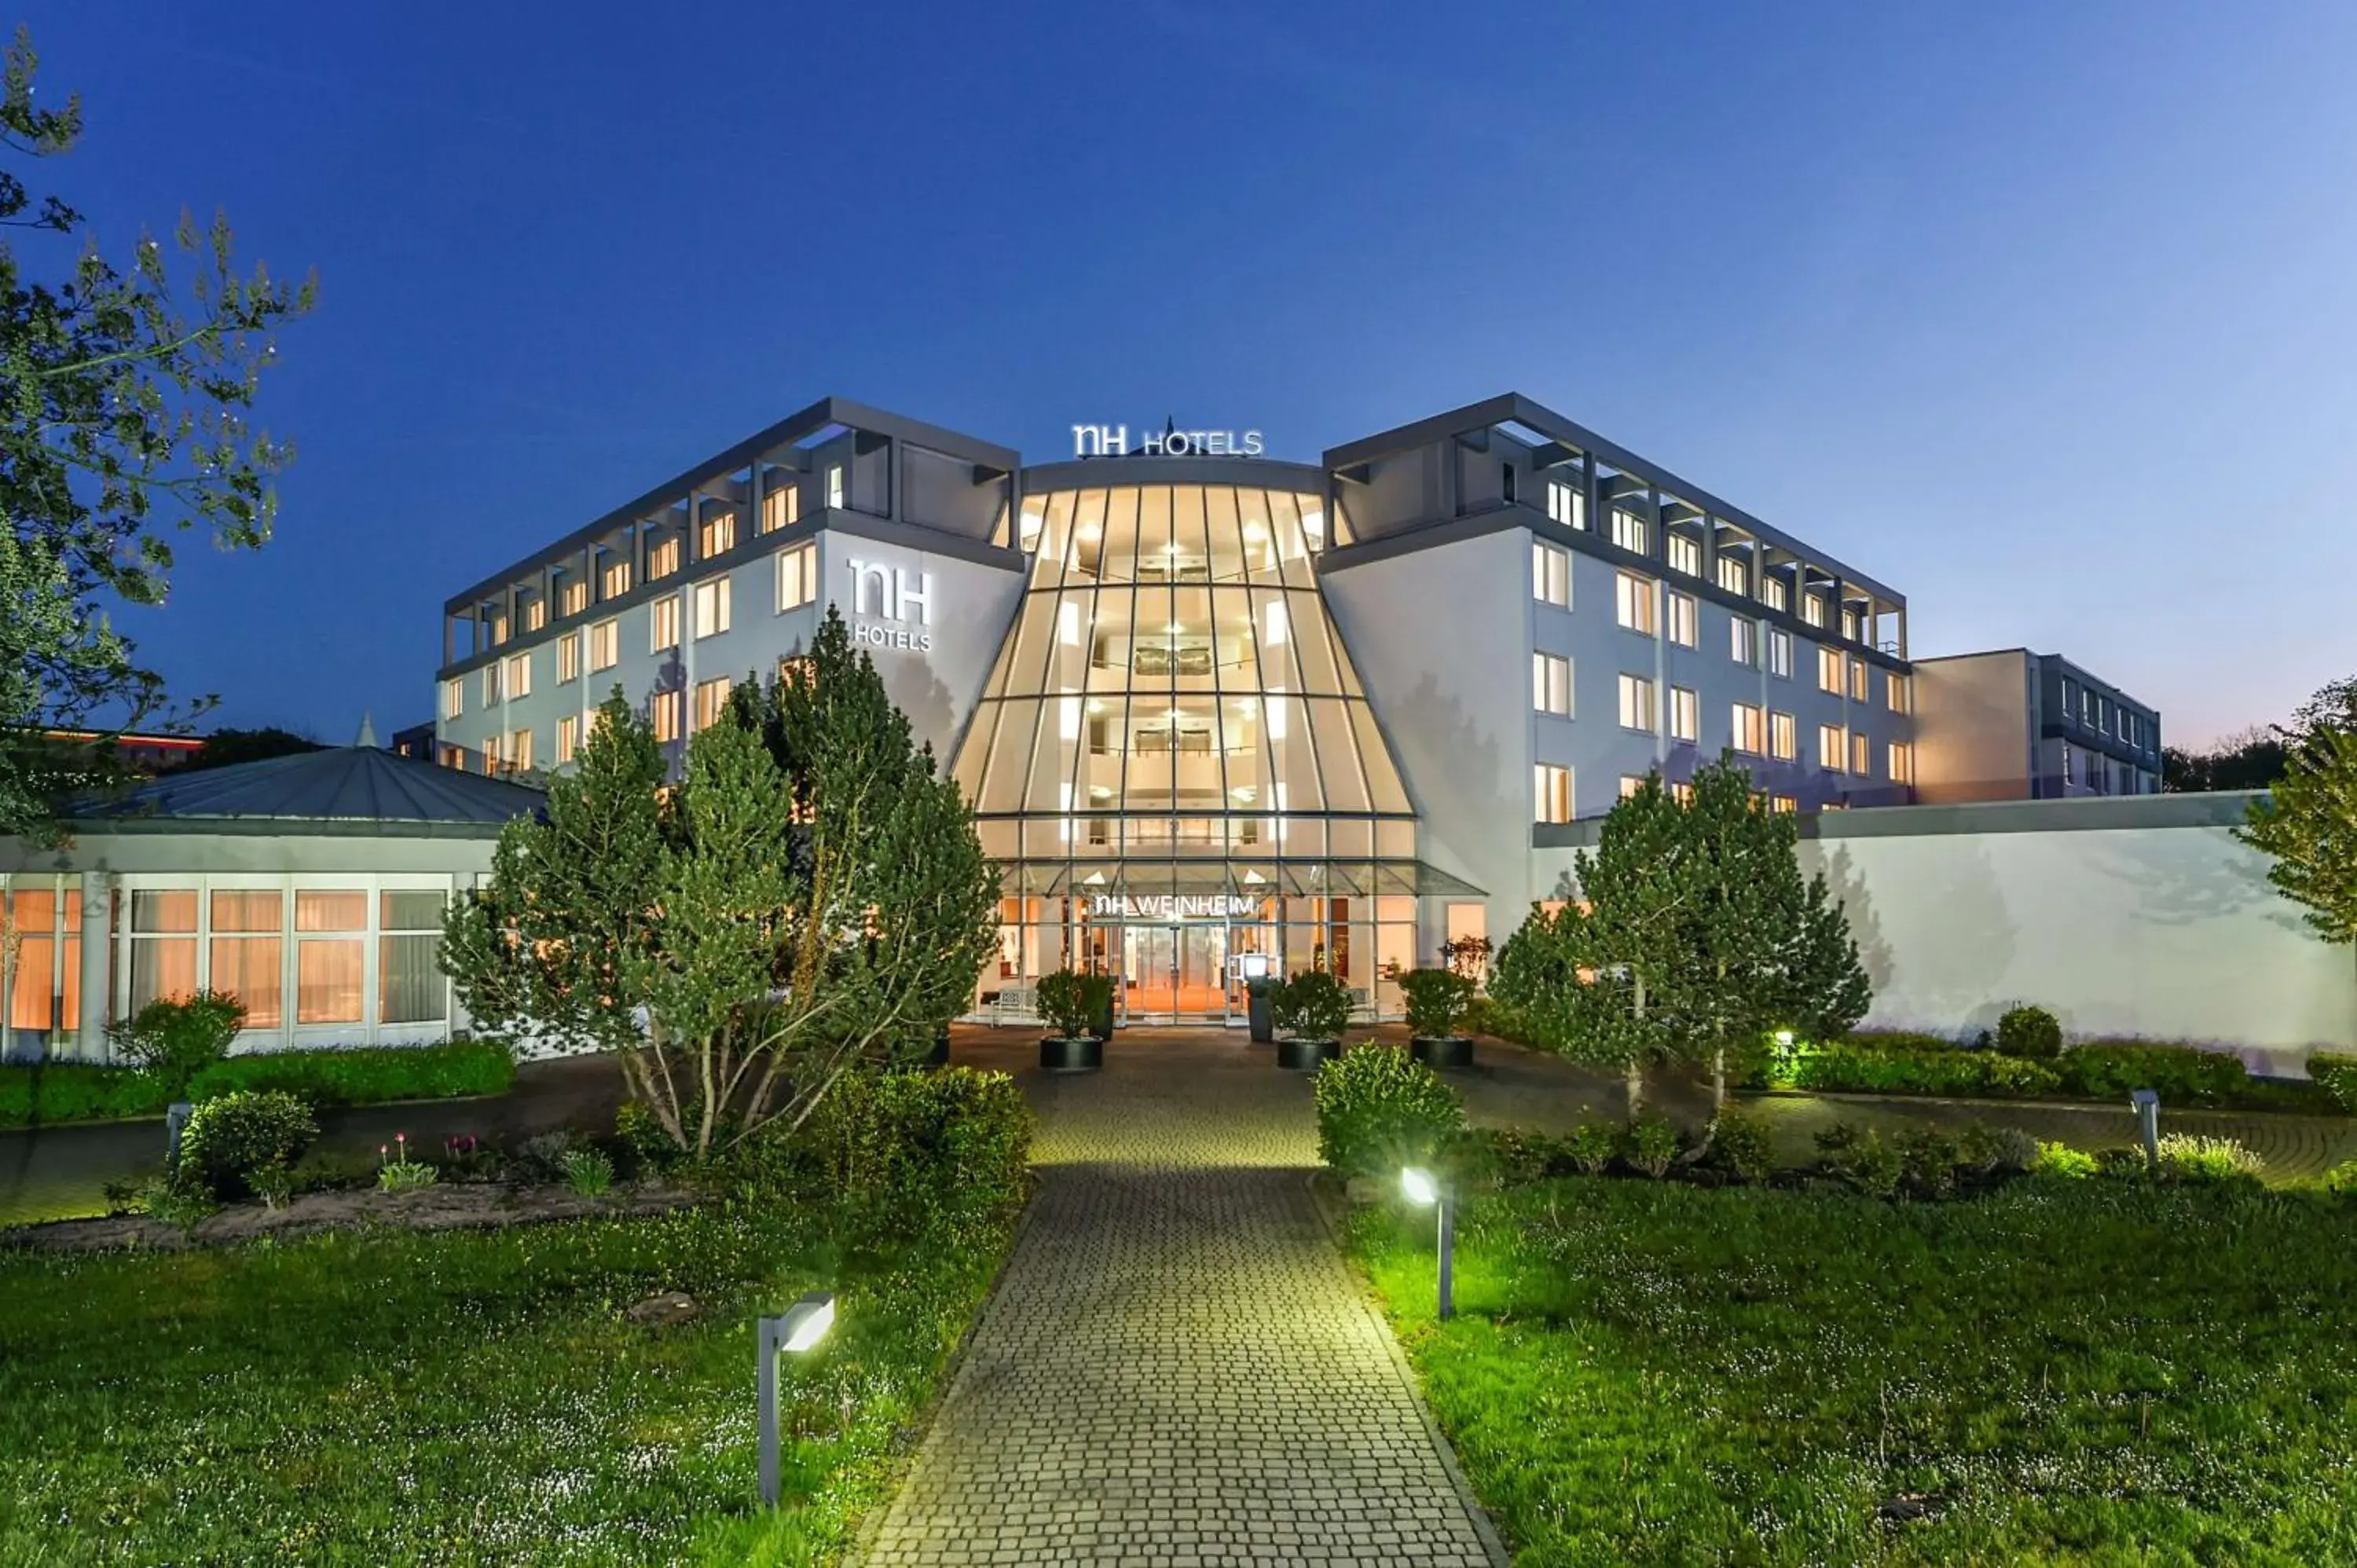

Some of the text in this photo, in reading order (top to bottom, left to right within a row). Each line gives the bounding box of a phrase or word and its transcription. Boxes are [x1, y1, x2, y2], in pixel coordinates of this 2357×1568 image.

[1145, 432, 1263, 455] HOTELS
[852, 624, 931, 652] HOTELS
[1136, 895, 1253, 914] WEINHEIM
